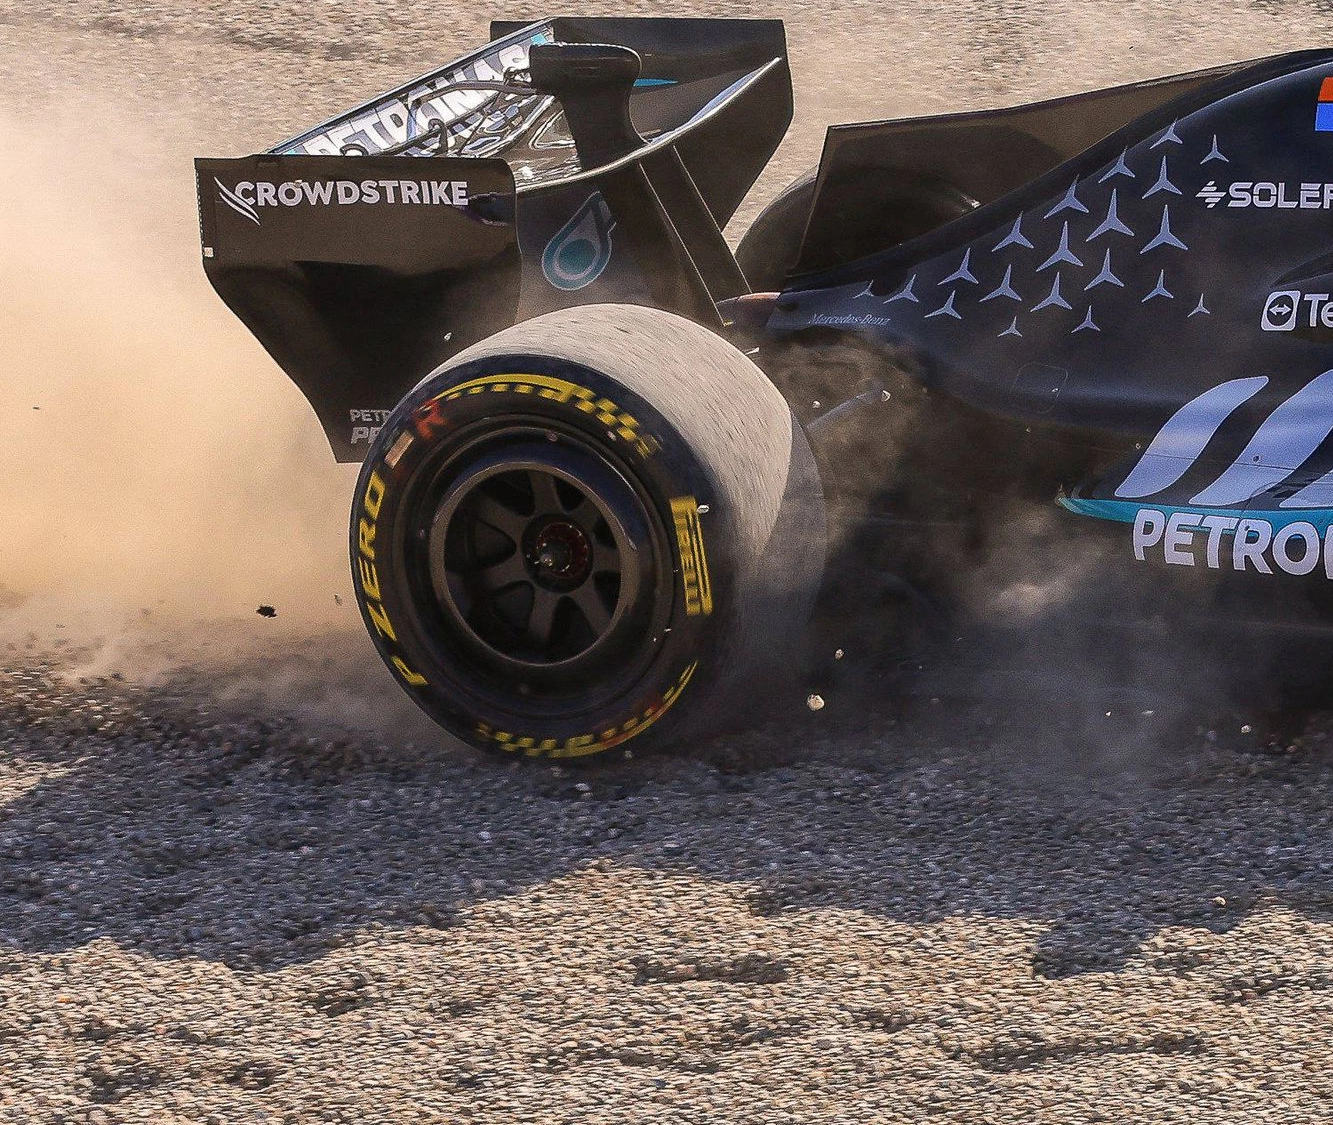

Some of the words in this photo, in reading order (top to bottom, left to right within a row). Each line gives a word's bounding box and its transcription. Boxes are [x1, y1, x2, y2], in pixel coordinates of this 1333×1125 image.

[234, 180, 469, 208] CROWDSTRIKE
[808, 313, 891, 326] Mercedes-Benz
[356, 469, 397, 643] ZERO
